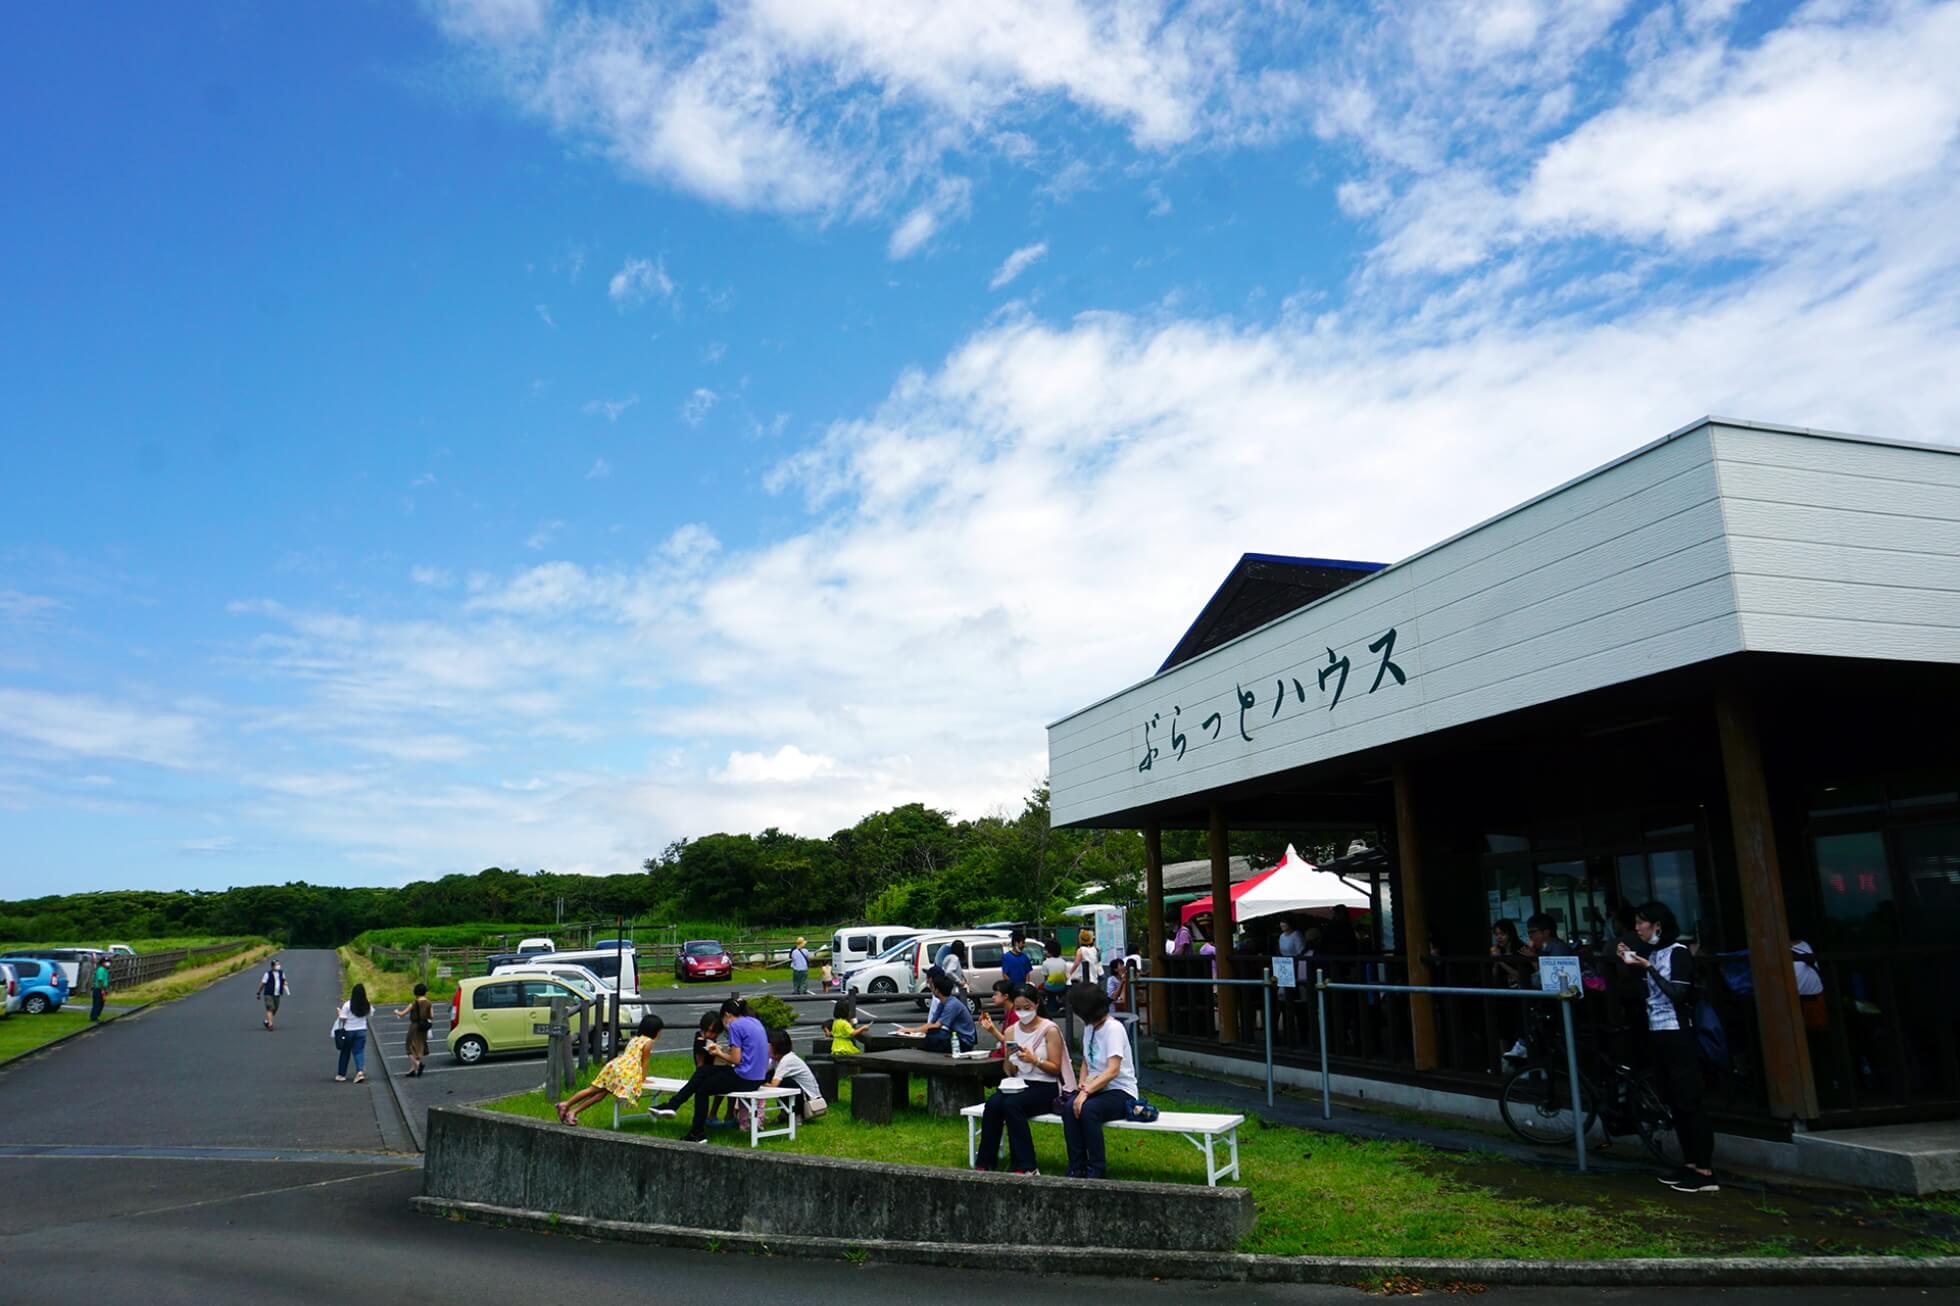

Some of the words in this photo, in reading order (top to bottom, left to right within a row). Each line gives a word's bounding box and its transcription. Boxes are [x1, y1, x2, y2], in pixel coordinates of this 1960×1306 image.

[1139, 628, 1406, 773] ぶらっとハウス
